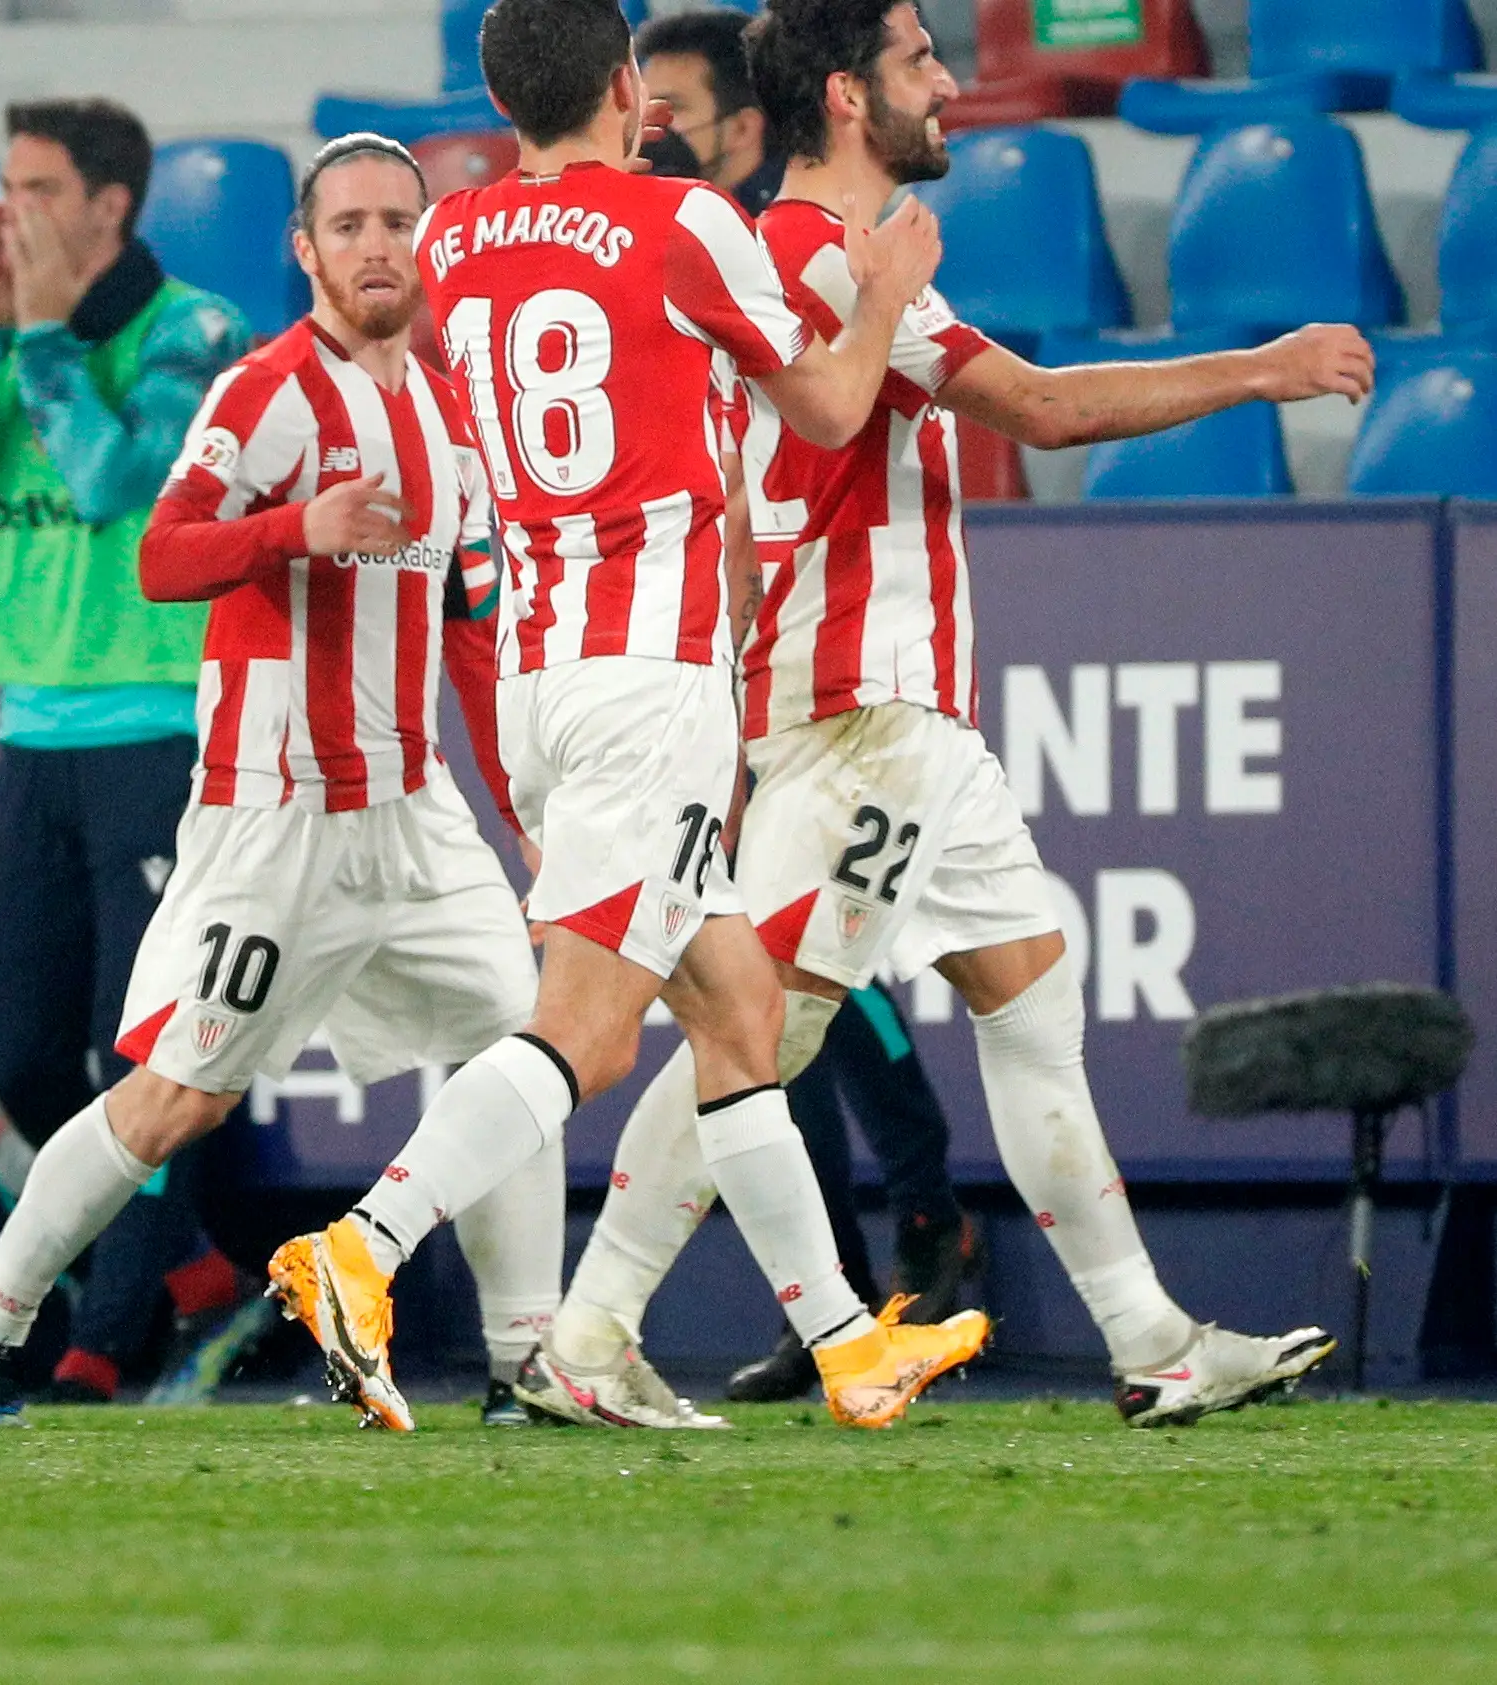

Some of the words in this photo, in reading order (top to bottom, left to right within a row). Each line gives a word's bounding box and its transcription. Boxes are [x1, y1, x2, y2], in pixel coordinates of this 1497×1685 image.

[429, 223, 466, 283] DE
[471, 203, 634, 268] MARCOS
[441, 286, 617, 498] 18
[830, 804, 922, 907] 22
[196, 920, 281, 1014] 10
